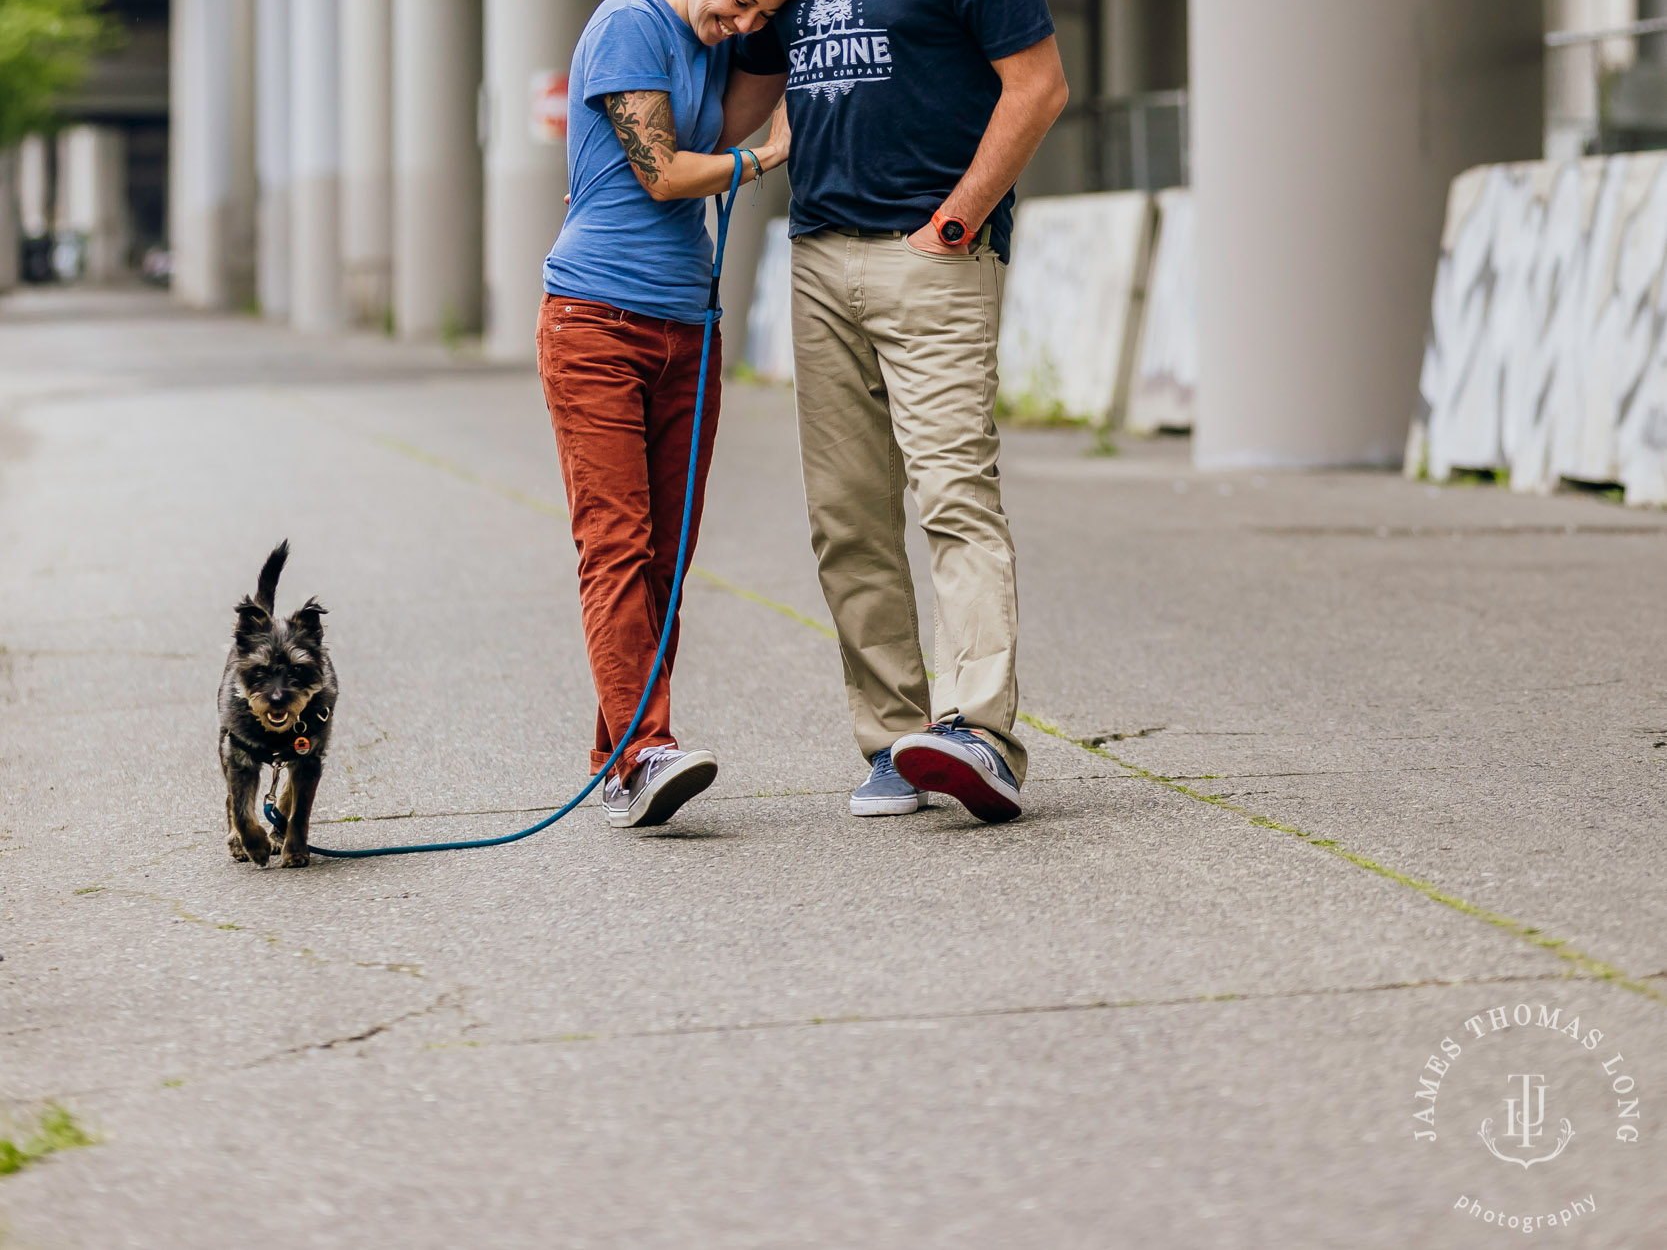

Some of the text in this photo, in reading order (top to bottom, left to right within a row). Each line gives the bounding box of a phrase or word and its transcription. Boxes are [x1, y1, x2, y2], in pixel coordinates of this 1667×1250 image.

[788, 36, 892, 75] SEAPINE
[786, 66, 893, 85] REWING COMPANY
